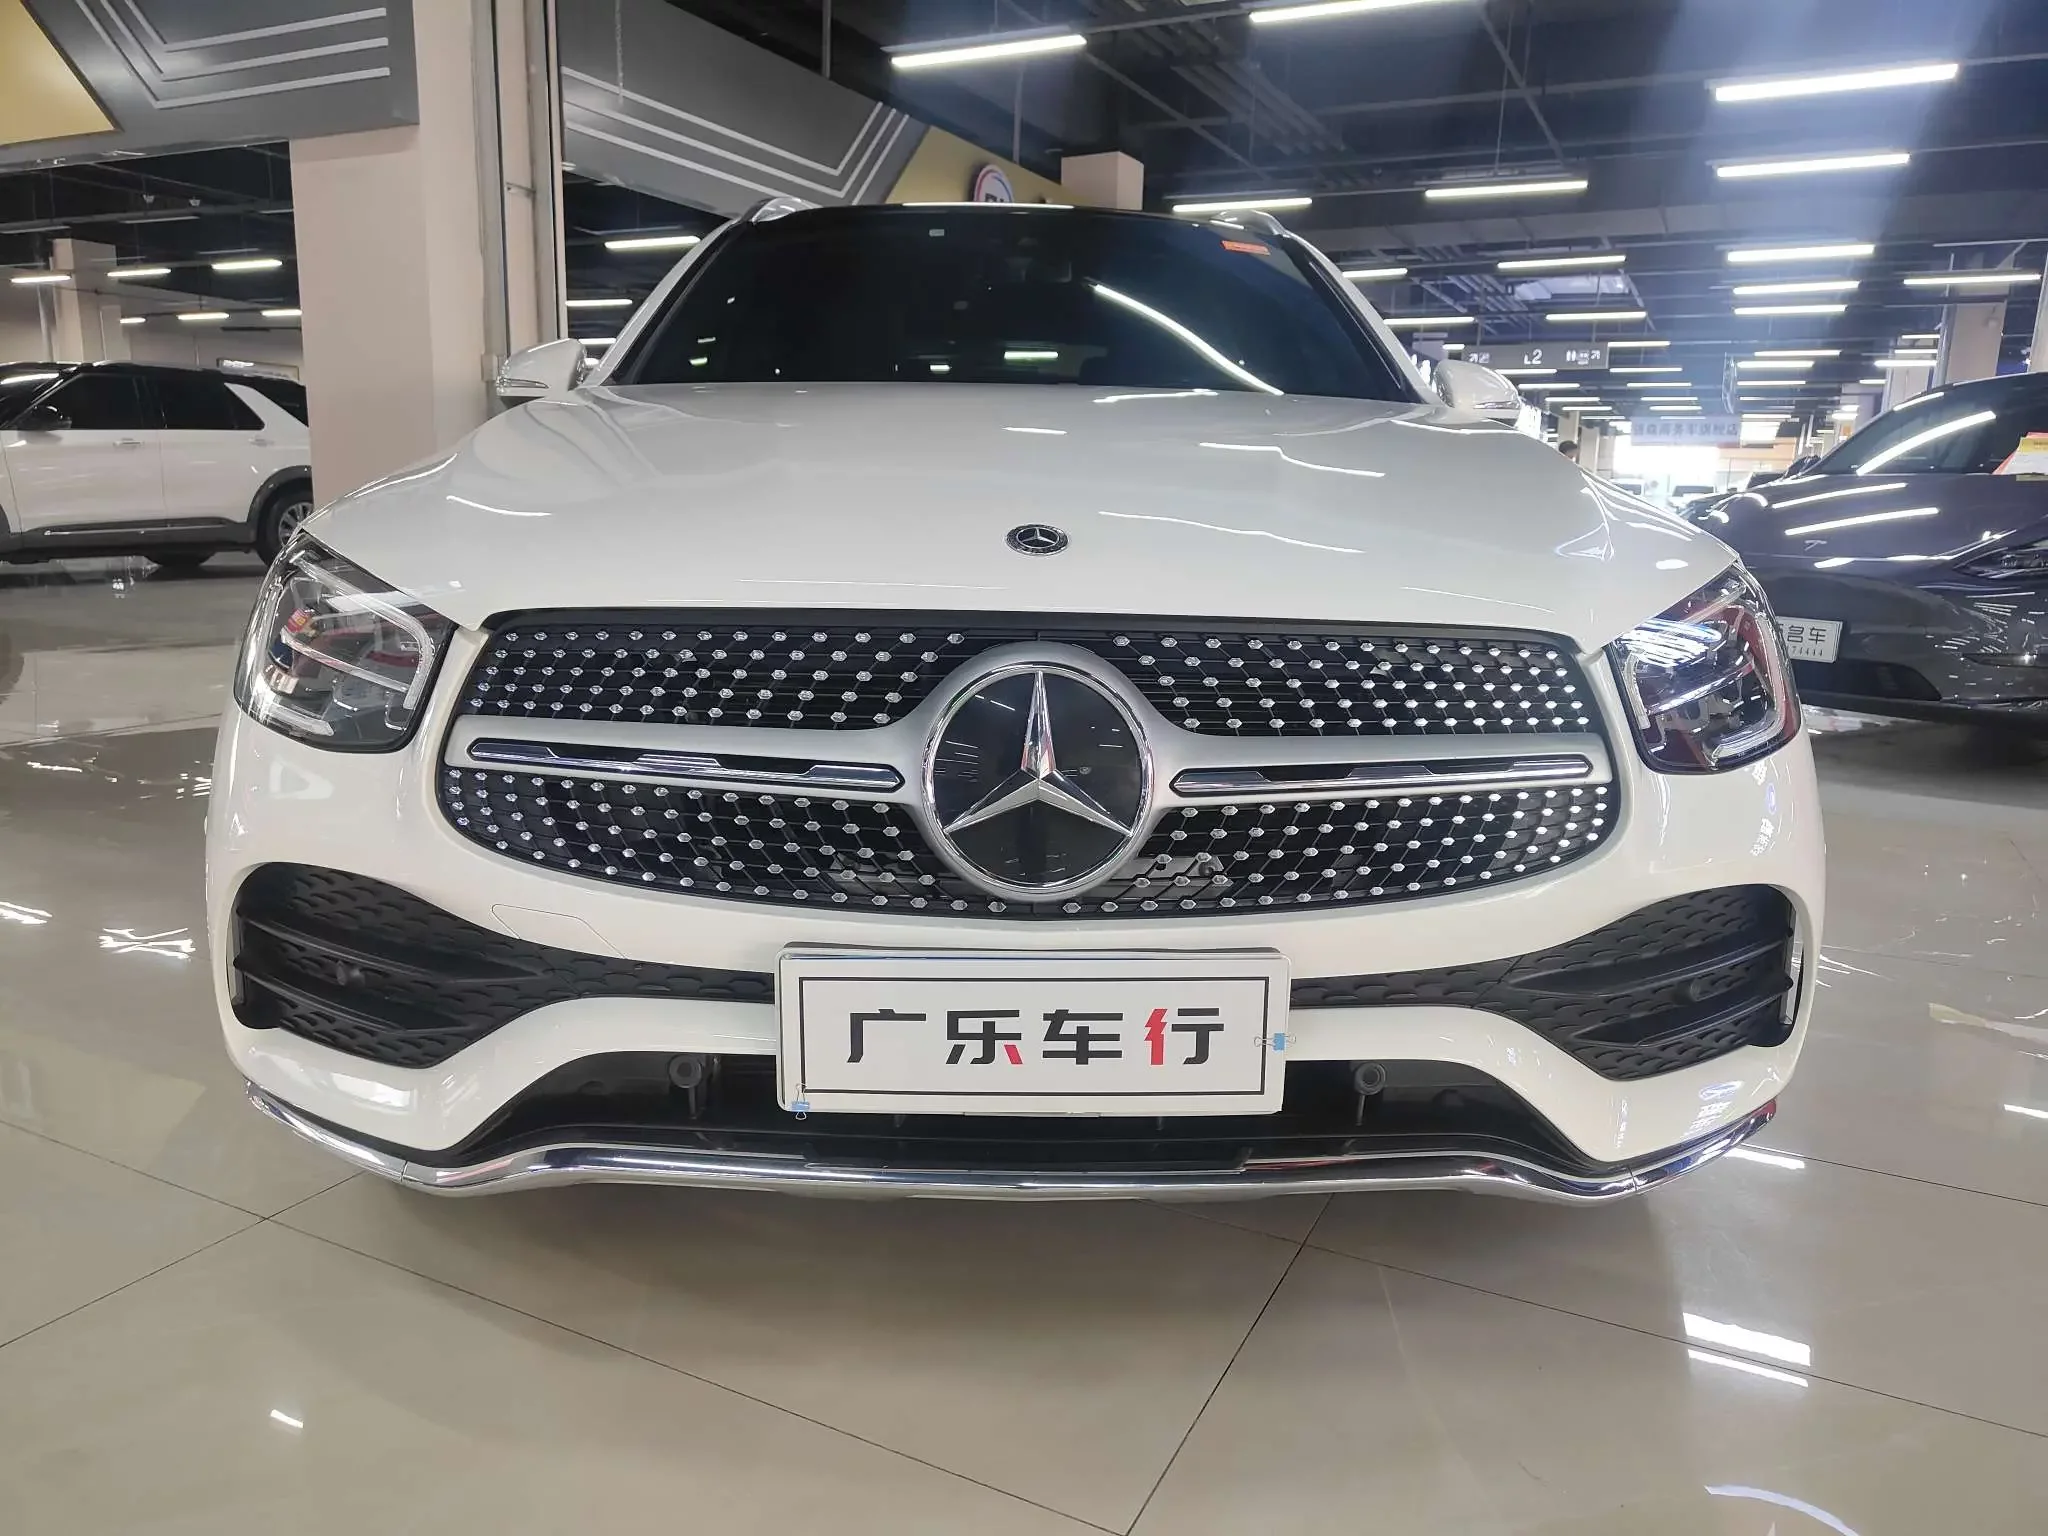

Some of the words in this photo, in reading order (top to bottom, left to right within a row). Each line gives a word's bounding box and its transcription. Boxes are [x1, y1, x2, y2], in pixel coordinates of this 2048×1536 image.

[1523, 349, 1543, 365] L2
[847, 1007, 1225, 1065] 广乐车行
